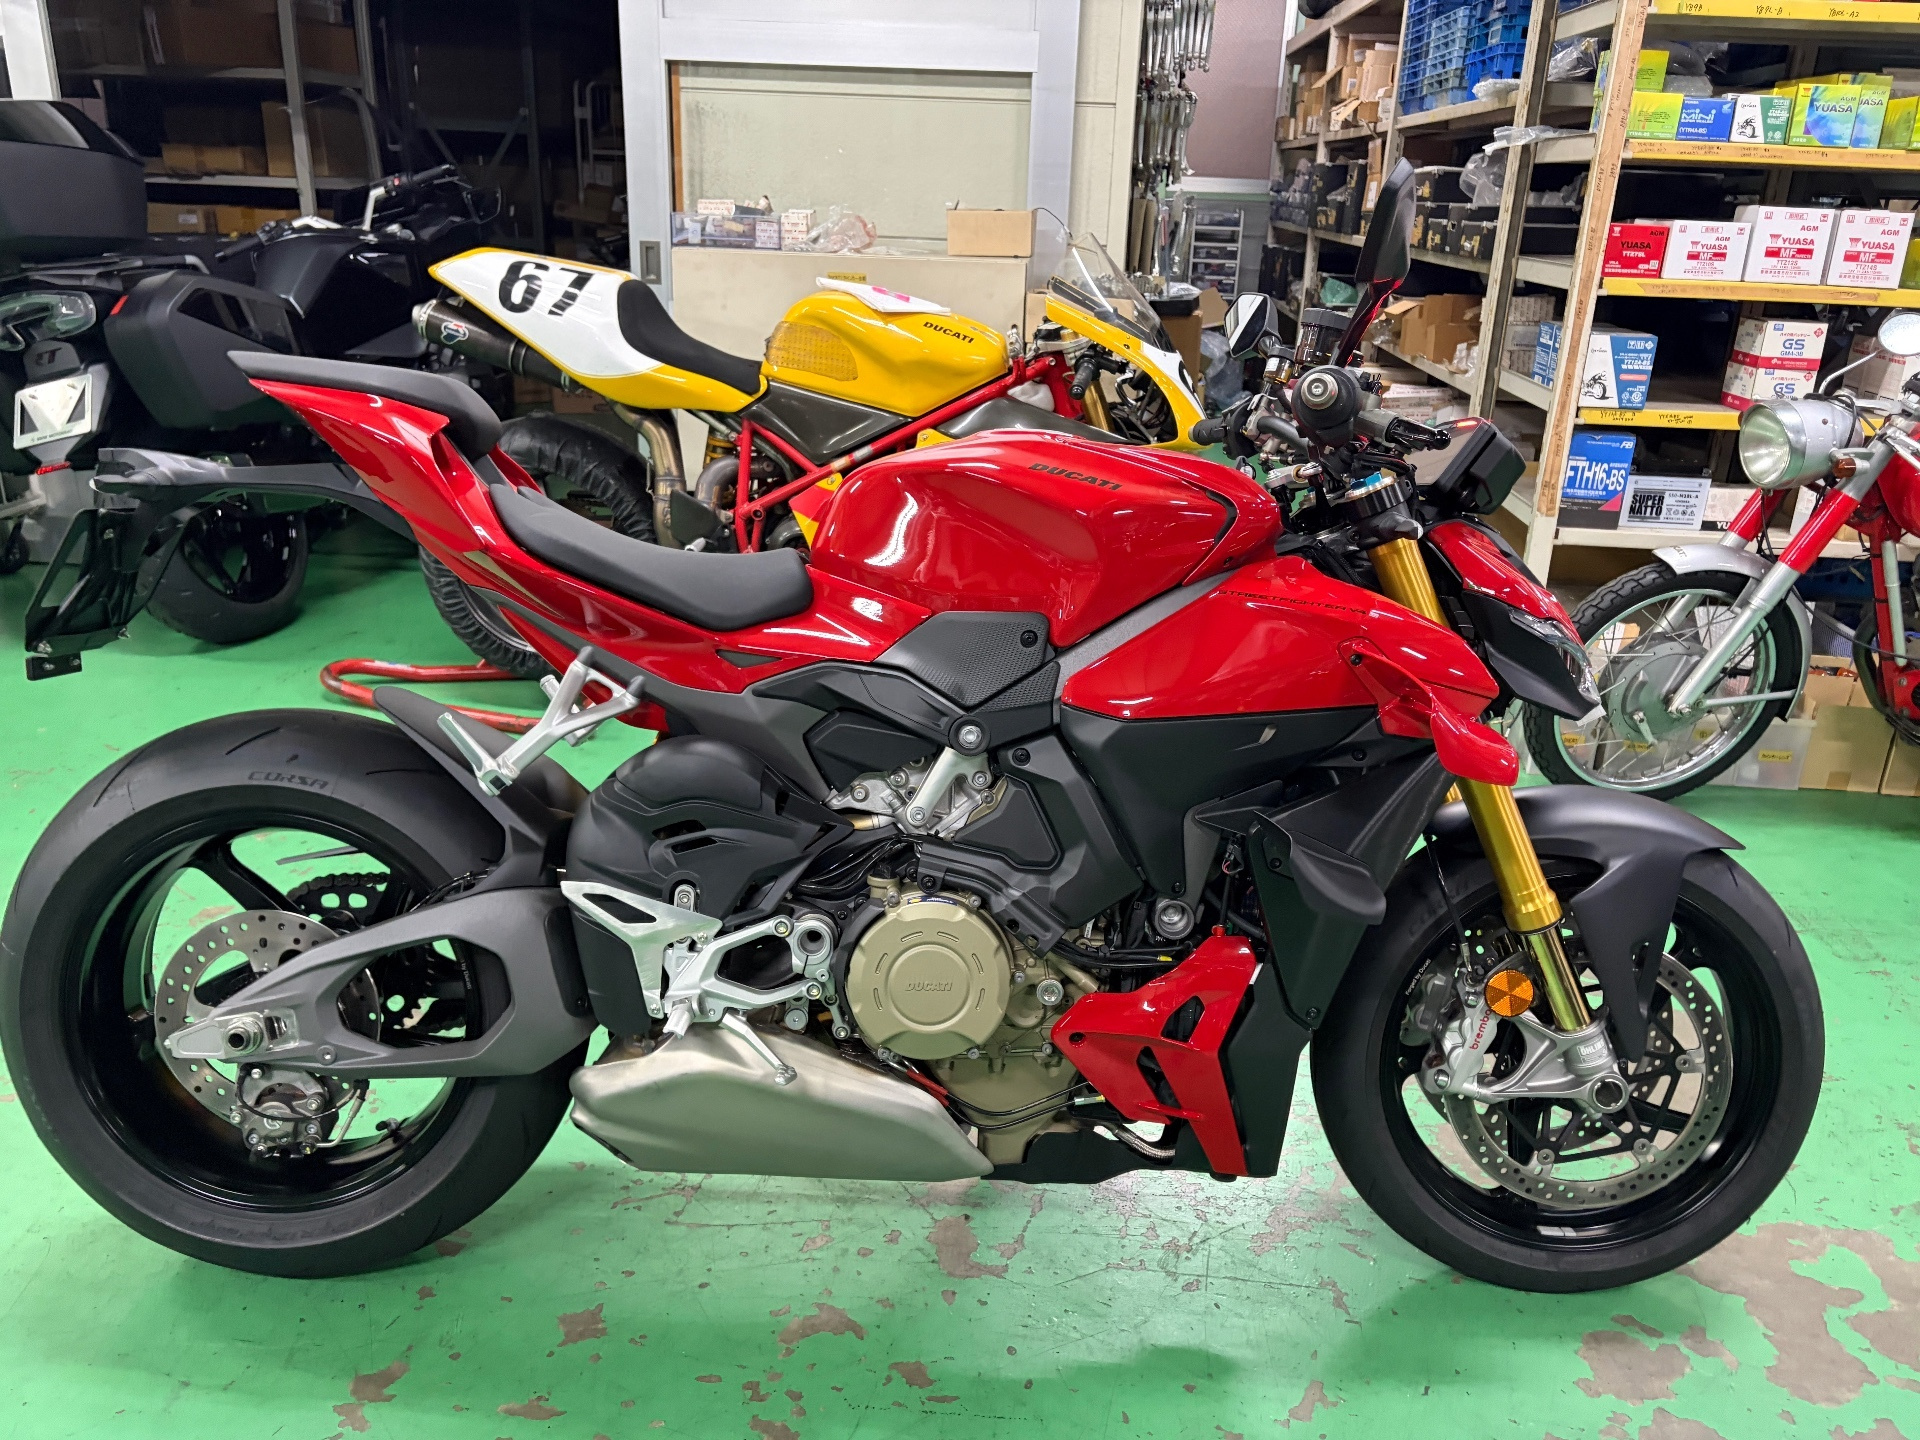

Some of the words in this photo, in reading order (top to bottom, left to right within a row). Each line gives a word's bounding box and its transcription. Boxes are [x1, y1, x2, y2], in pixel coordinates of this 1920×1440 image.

[1814, 102, 1853, 113] YUASA
[1621, 241, 1651, 249] YUASA
[1701, 243, 1728, 251] YUASA
[1781, 237, 1815, 246] YUASA
[1861, 241, 1895, 250] YUASA
[1699, 251, 1713, 261] MF
[1780, 248, 1797, 258] MF
[1859, 252, 1877, 263] MF
[499, 260, 595, 317] 67
[922, 321, 975, 344] DUCATI
[1782, 338, 1806, 350] GS
[1773, 383, 1796, 394] GS
[1028, 463, 1123, 490] DUCATI
[1564, 460, 1626, 491] FTH16-BS
[1631, 493, 1665, 506] SUPER
[1629, 504, 1663, 517] NATTO
[1218, 589, 1347, 611] STREETFIGHTER
[247, 771, 329, 790] CORSA
[904, 982, 953, 992] DUCATI
[1469, 1009, 1492, 1050] brembo
